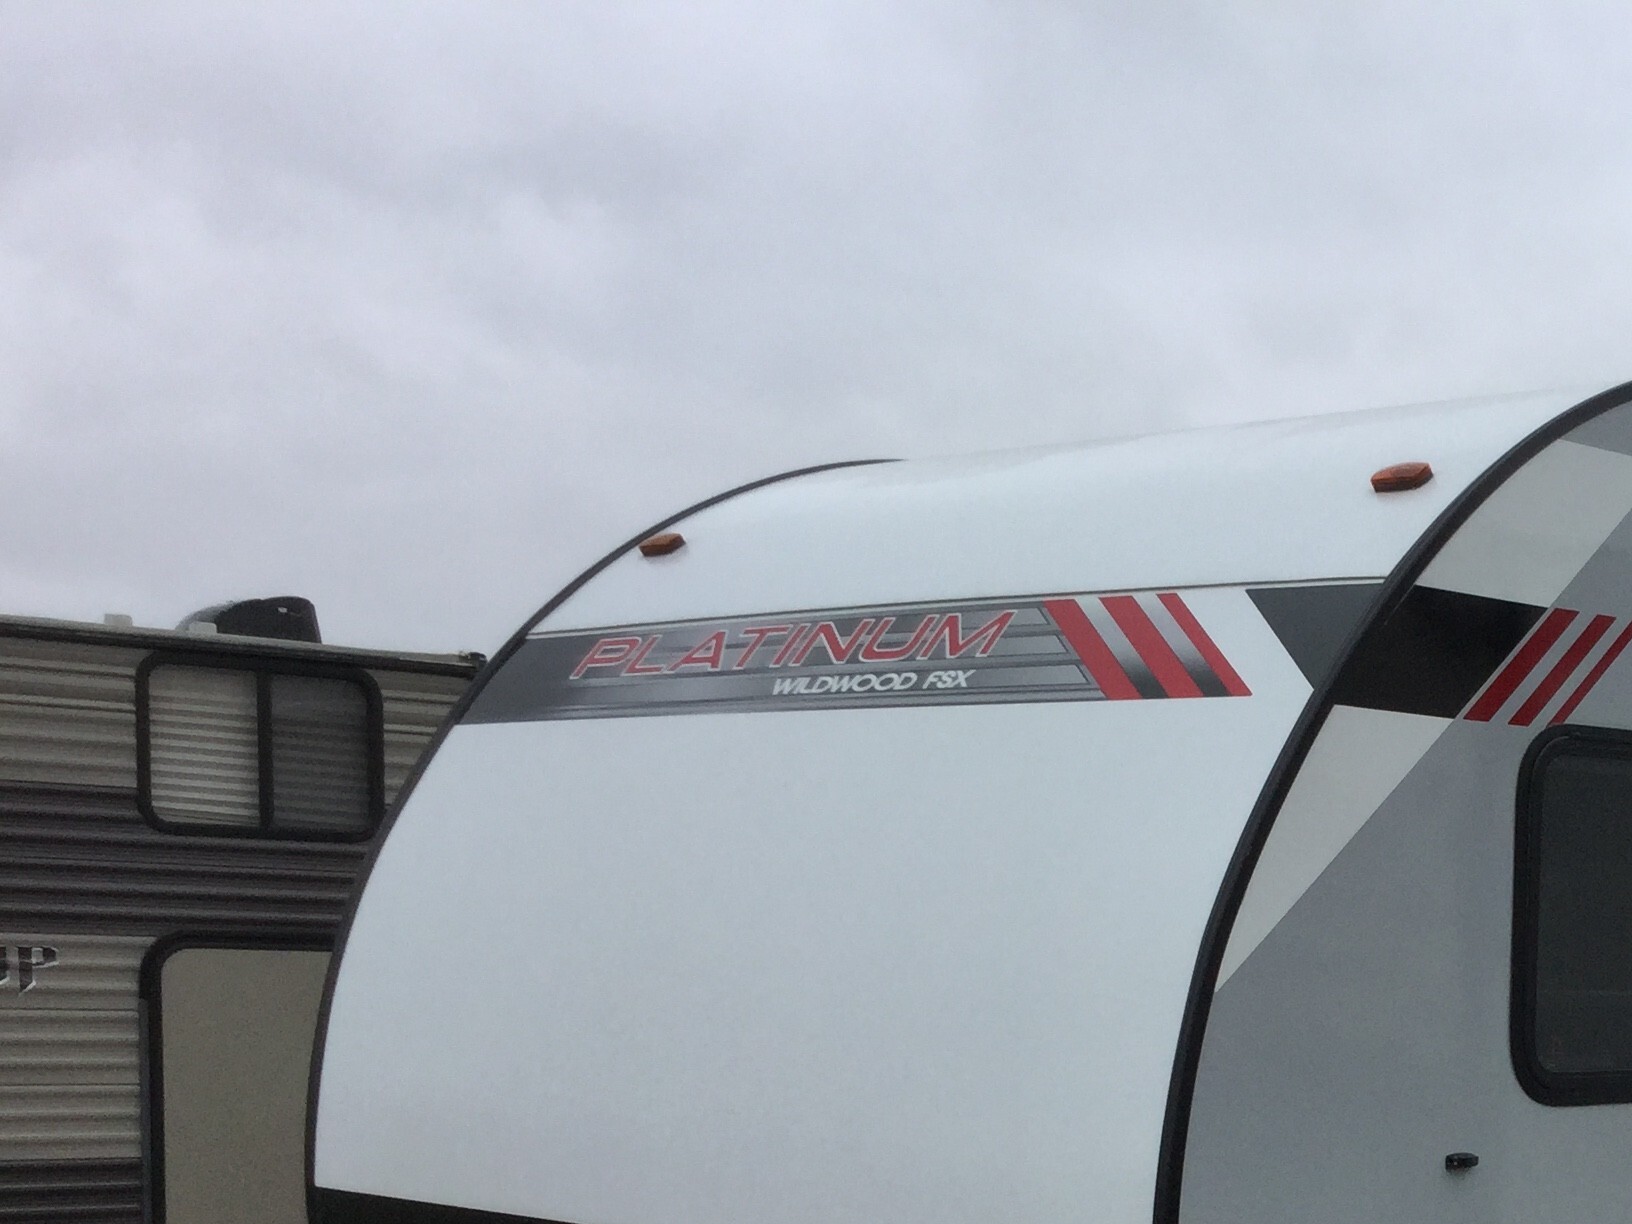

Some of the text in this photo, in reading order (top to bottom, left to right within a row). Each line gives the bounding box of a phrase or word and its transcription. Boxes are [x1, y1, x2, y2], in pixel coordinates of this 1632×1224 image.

[569, 609, 1018, 681] PLATINUM
[771, 669, 977, 696] WILDWOOD FSX
